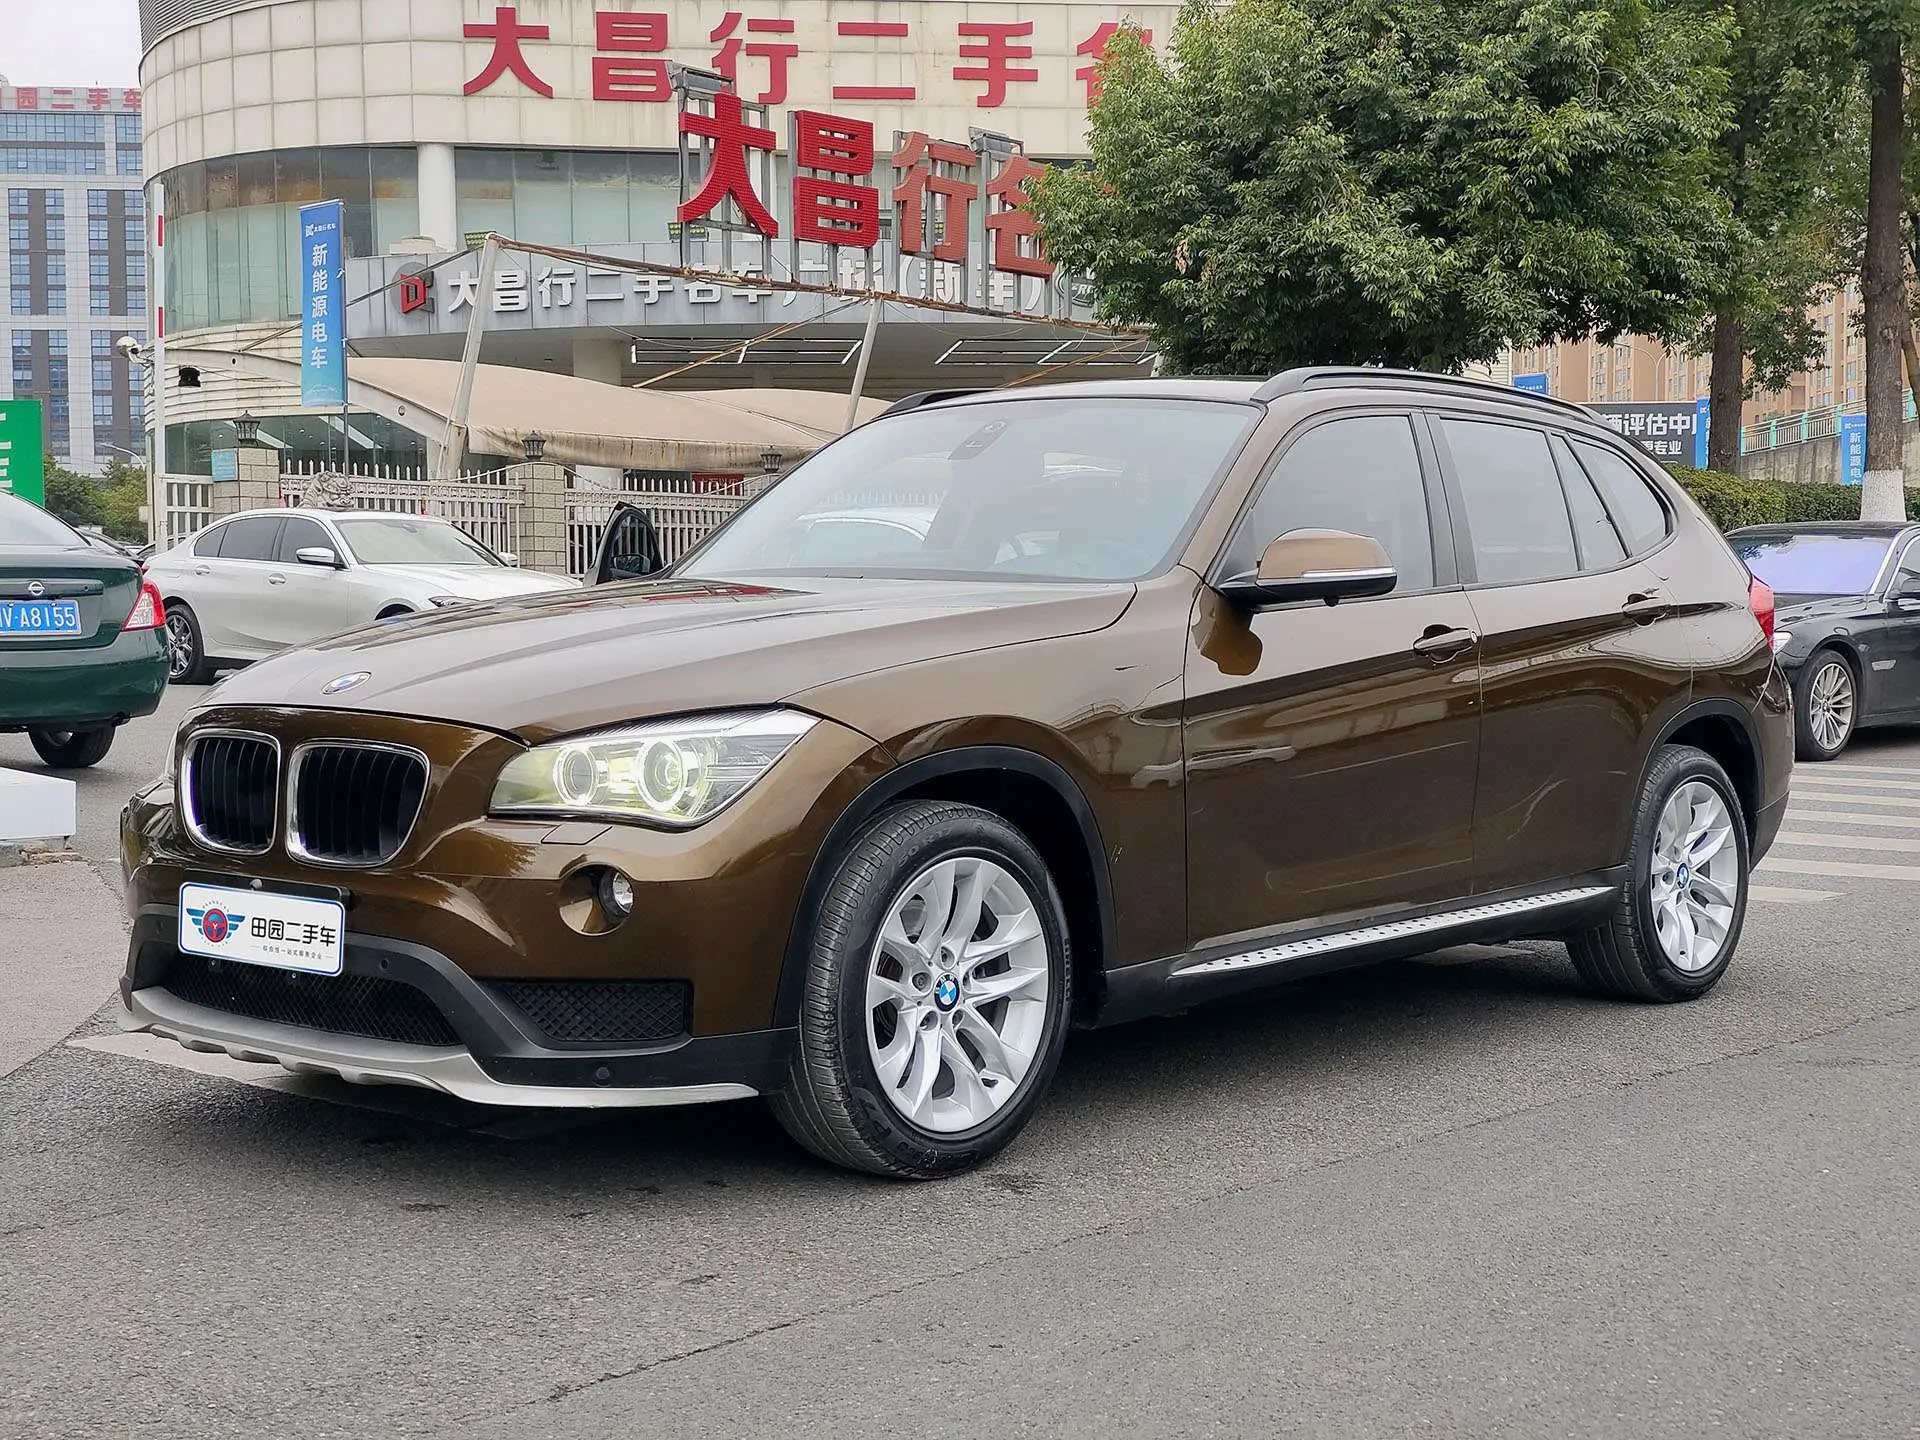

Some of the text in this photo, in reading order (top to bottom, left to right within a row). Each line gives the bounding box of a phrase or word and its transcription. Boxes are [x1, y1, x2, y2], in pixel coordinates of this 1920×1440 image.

[0, 87, 141, 111] 园二手车
[311, 243, 328, 369] 新能源电车
[1600, 413, 1697, 436] 评估中
[0, 606, 77, 628] V·A8155
[251, 916, 337, 947] 田园二手车
